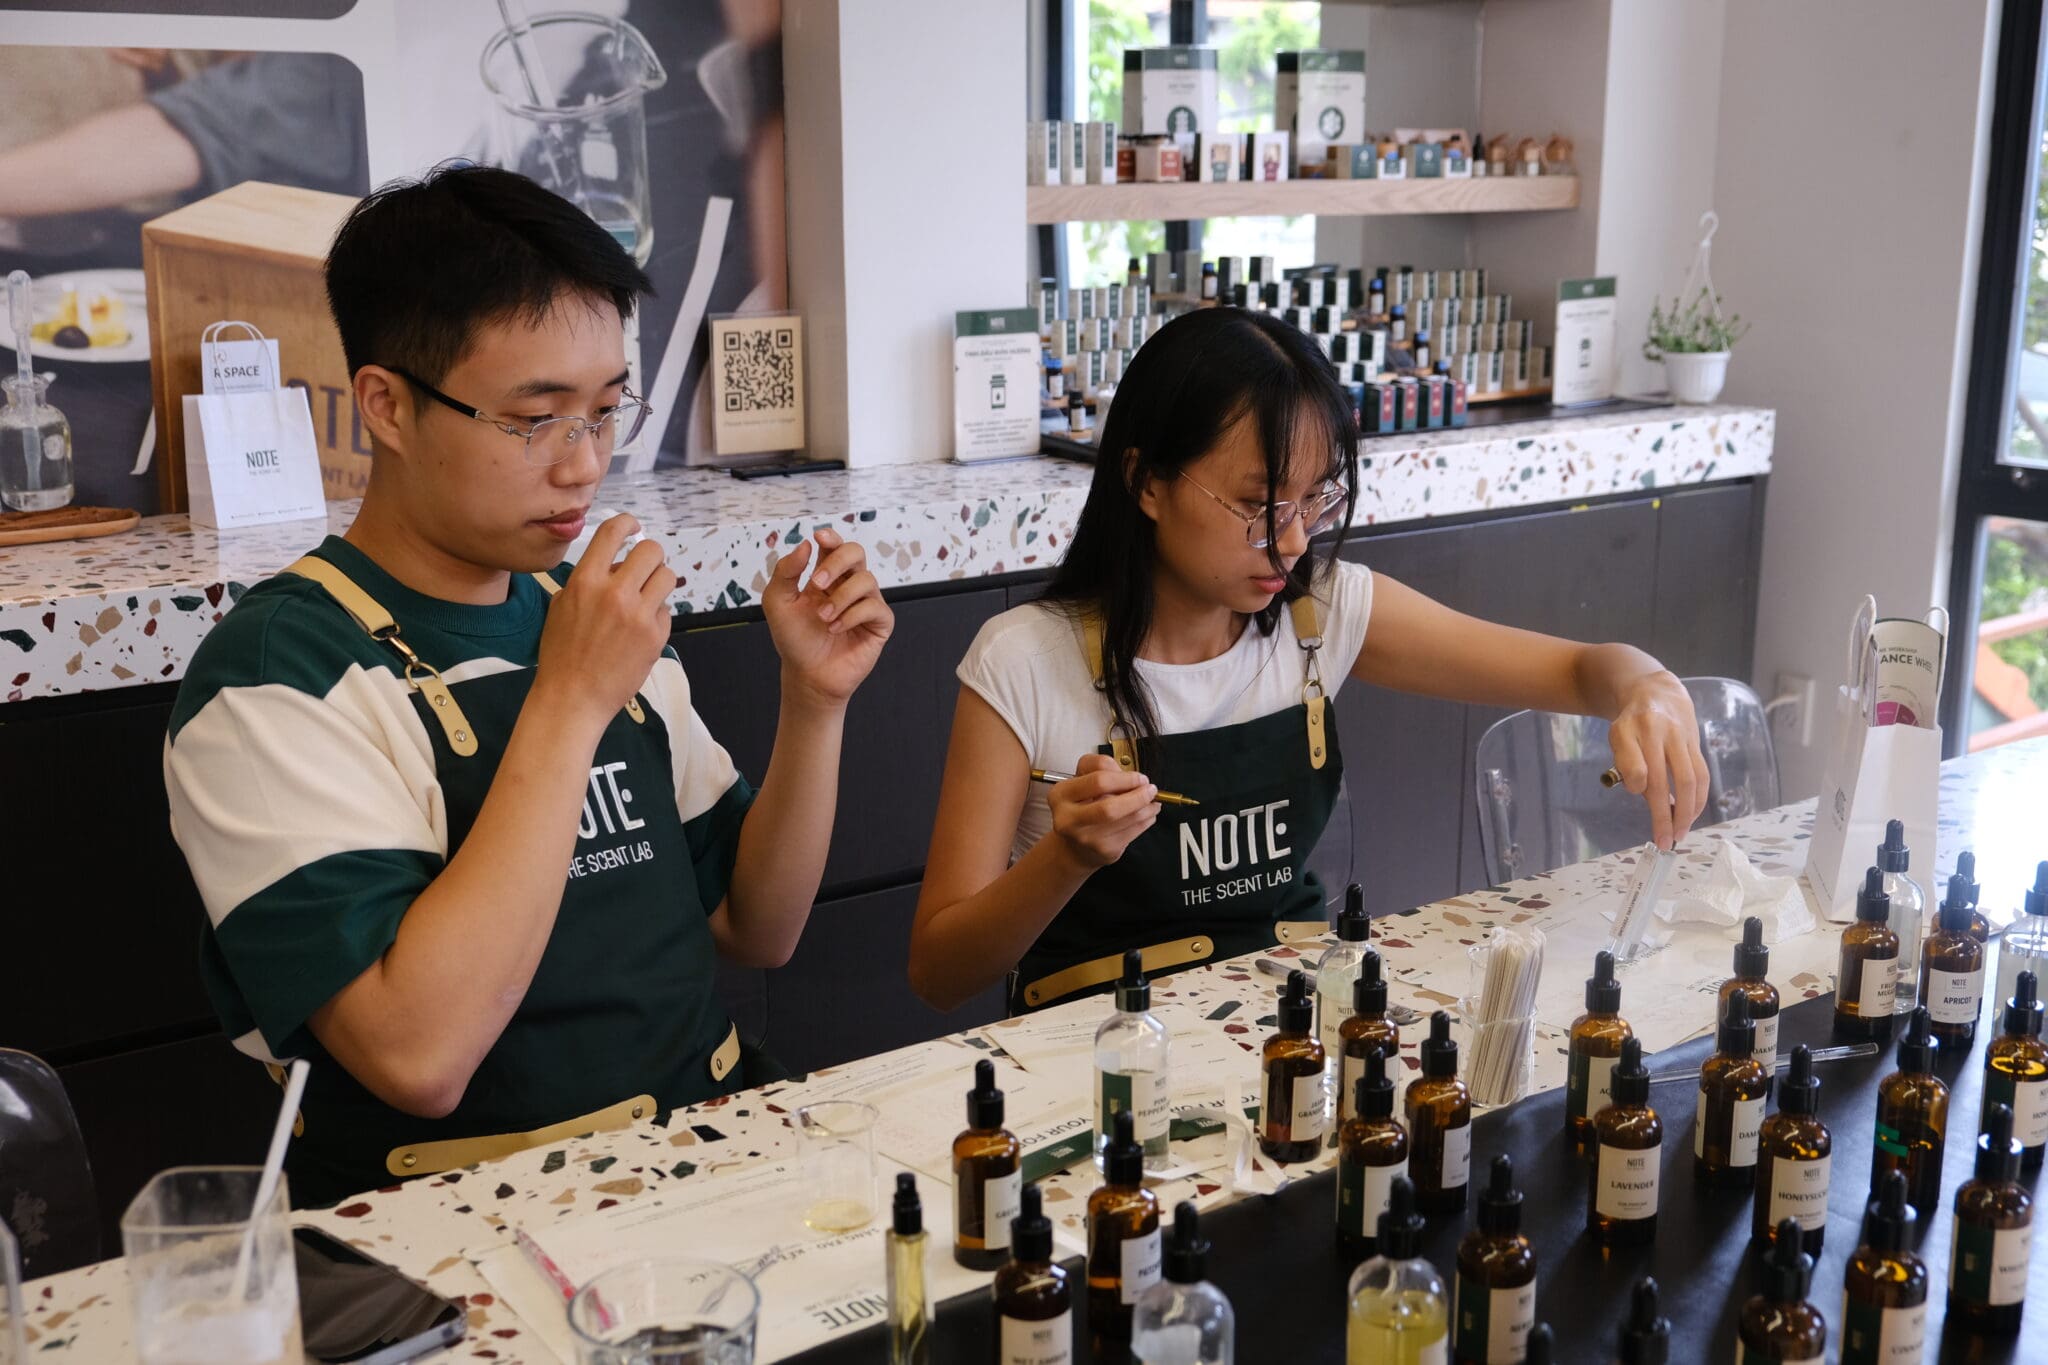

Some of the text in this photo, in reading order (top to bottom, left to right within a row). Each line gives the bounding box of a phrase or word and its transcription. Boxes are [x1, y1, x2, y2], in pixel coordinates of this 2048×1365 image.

[246, 450, 280, 468] NOTE
[1880, 654, 1914, 665] ANCE
[1179, 799, 1292, 880] NOTE
[586, 845, 630, 873] SCENT
[629, 840, 655, 863] LAB
[1181, 866, 1293, 906] THE SCENT LAB
[1943, 996, 1973, 1006] APRICOT
[1045, 1117, 1093, 1137] YOUR
